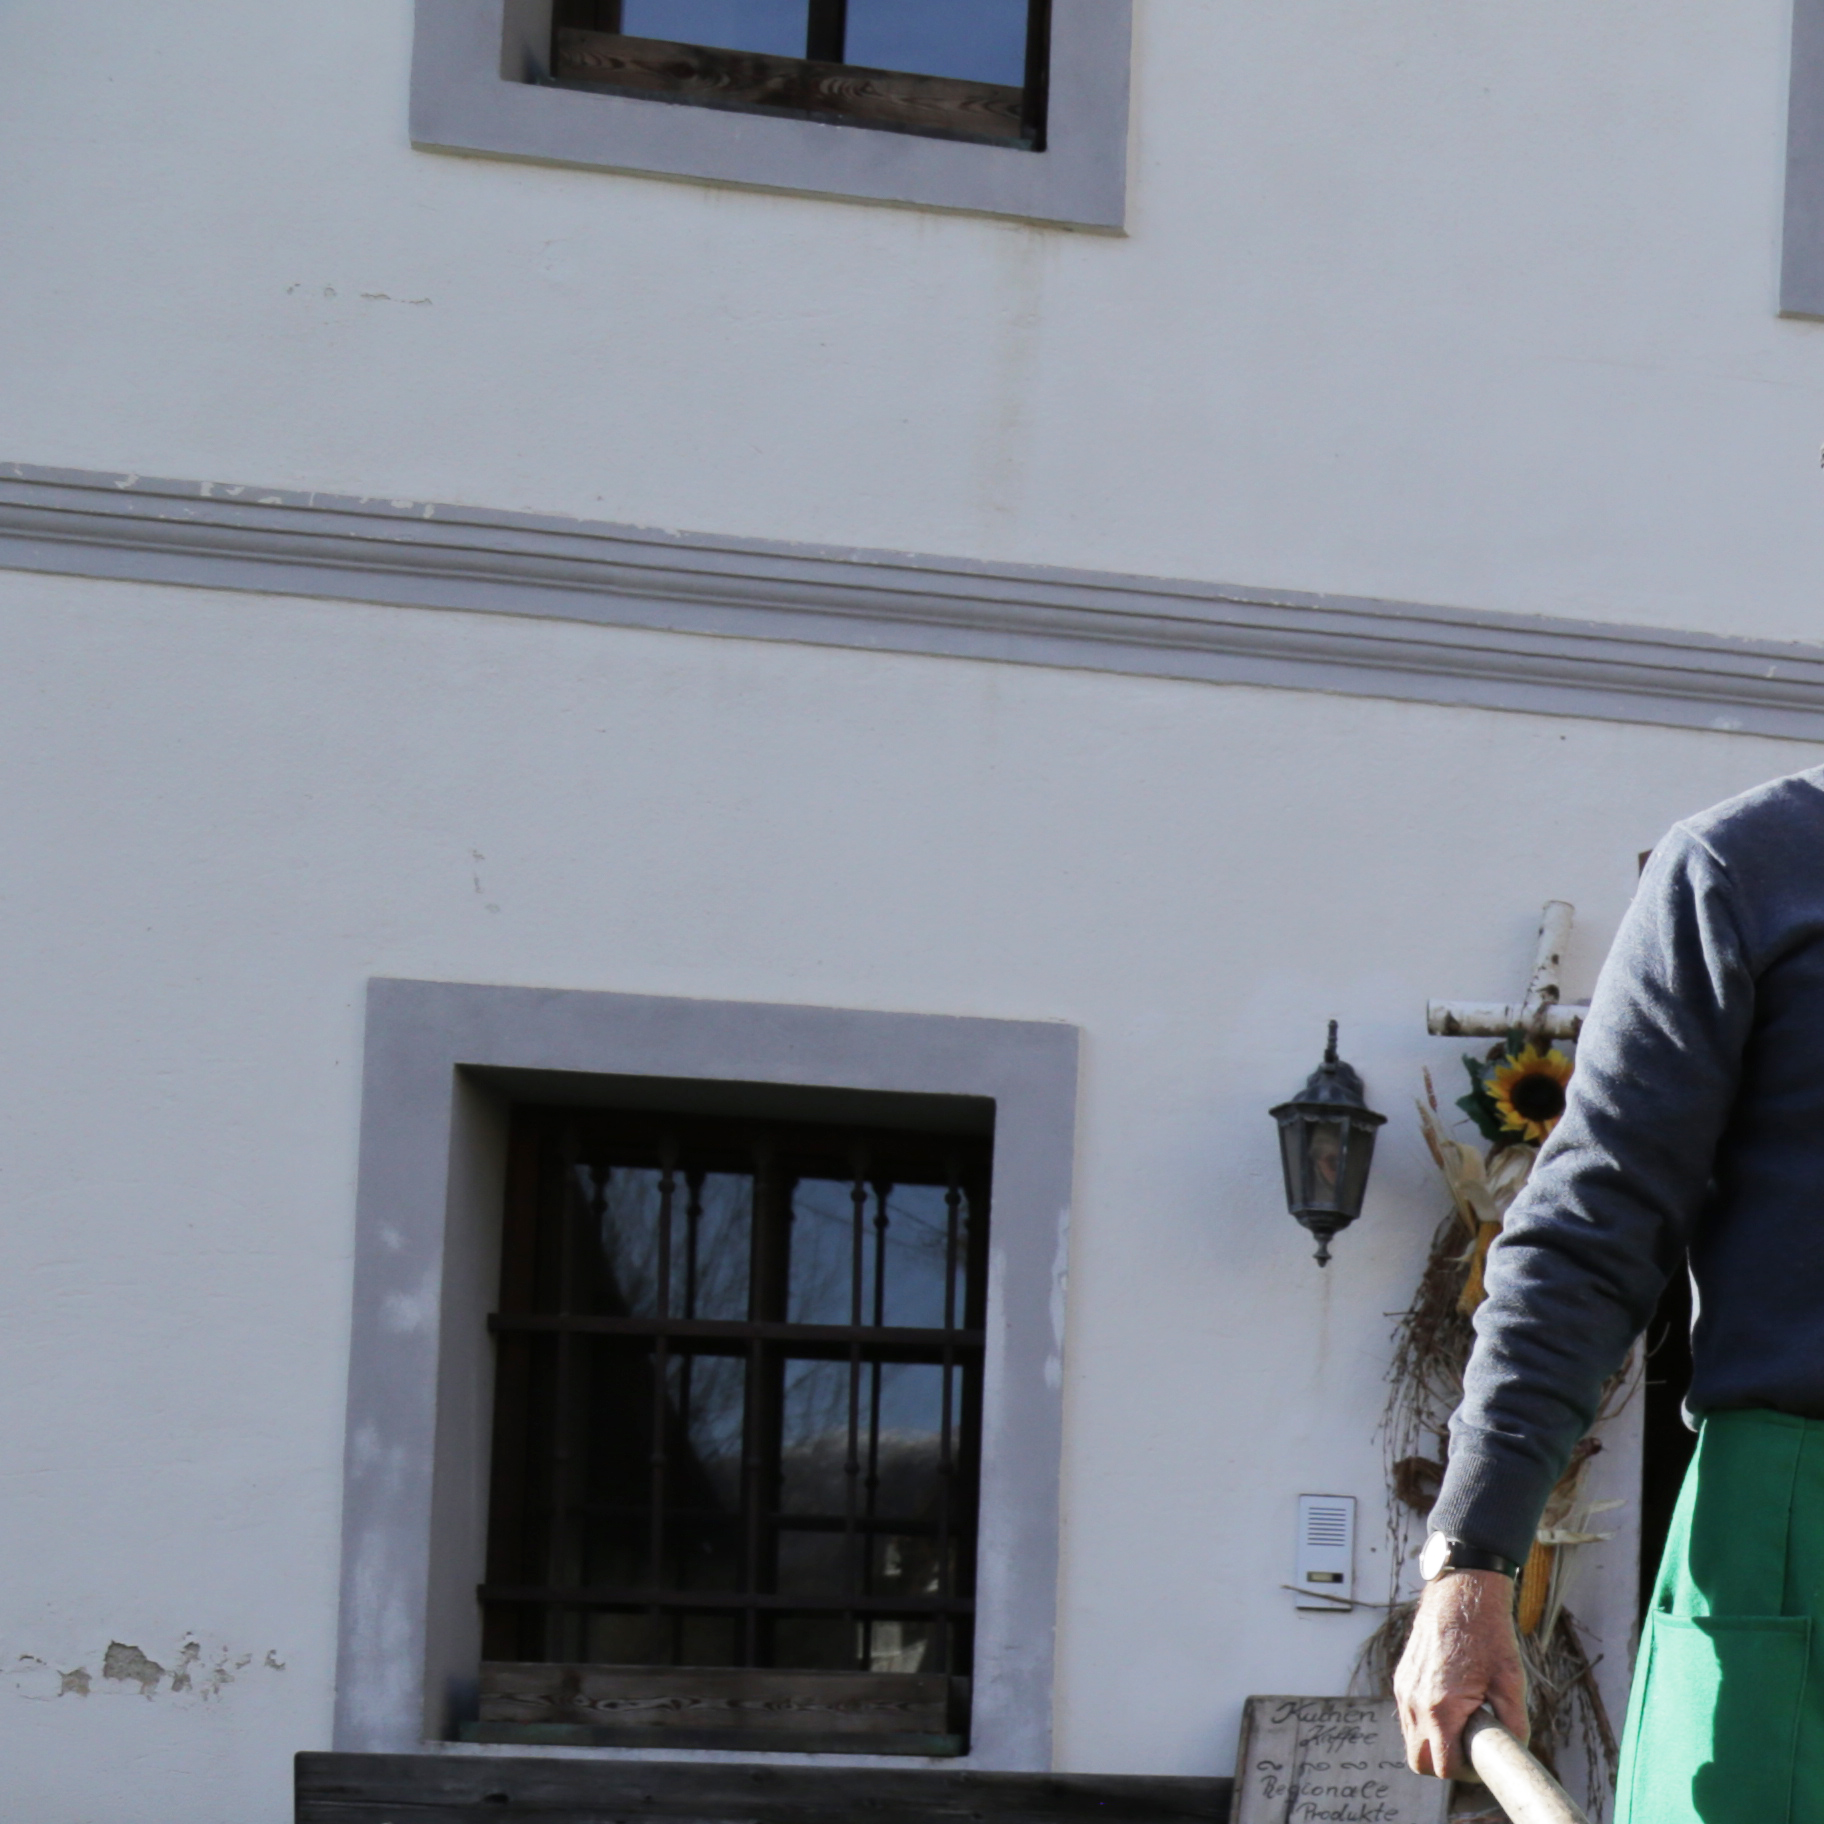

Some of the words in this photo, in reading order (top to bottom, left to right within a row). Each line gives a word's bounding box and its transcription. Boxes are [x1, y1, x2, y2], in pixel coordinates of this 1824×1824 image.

[1298, 1724, 1379, 1754] Kaffee
[1260, 1774, 1389, 1799] Regionale
[1296, 1801, 1399, 1823] Produkte
